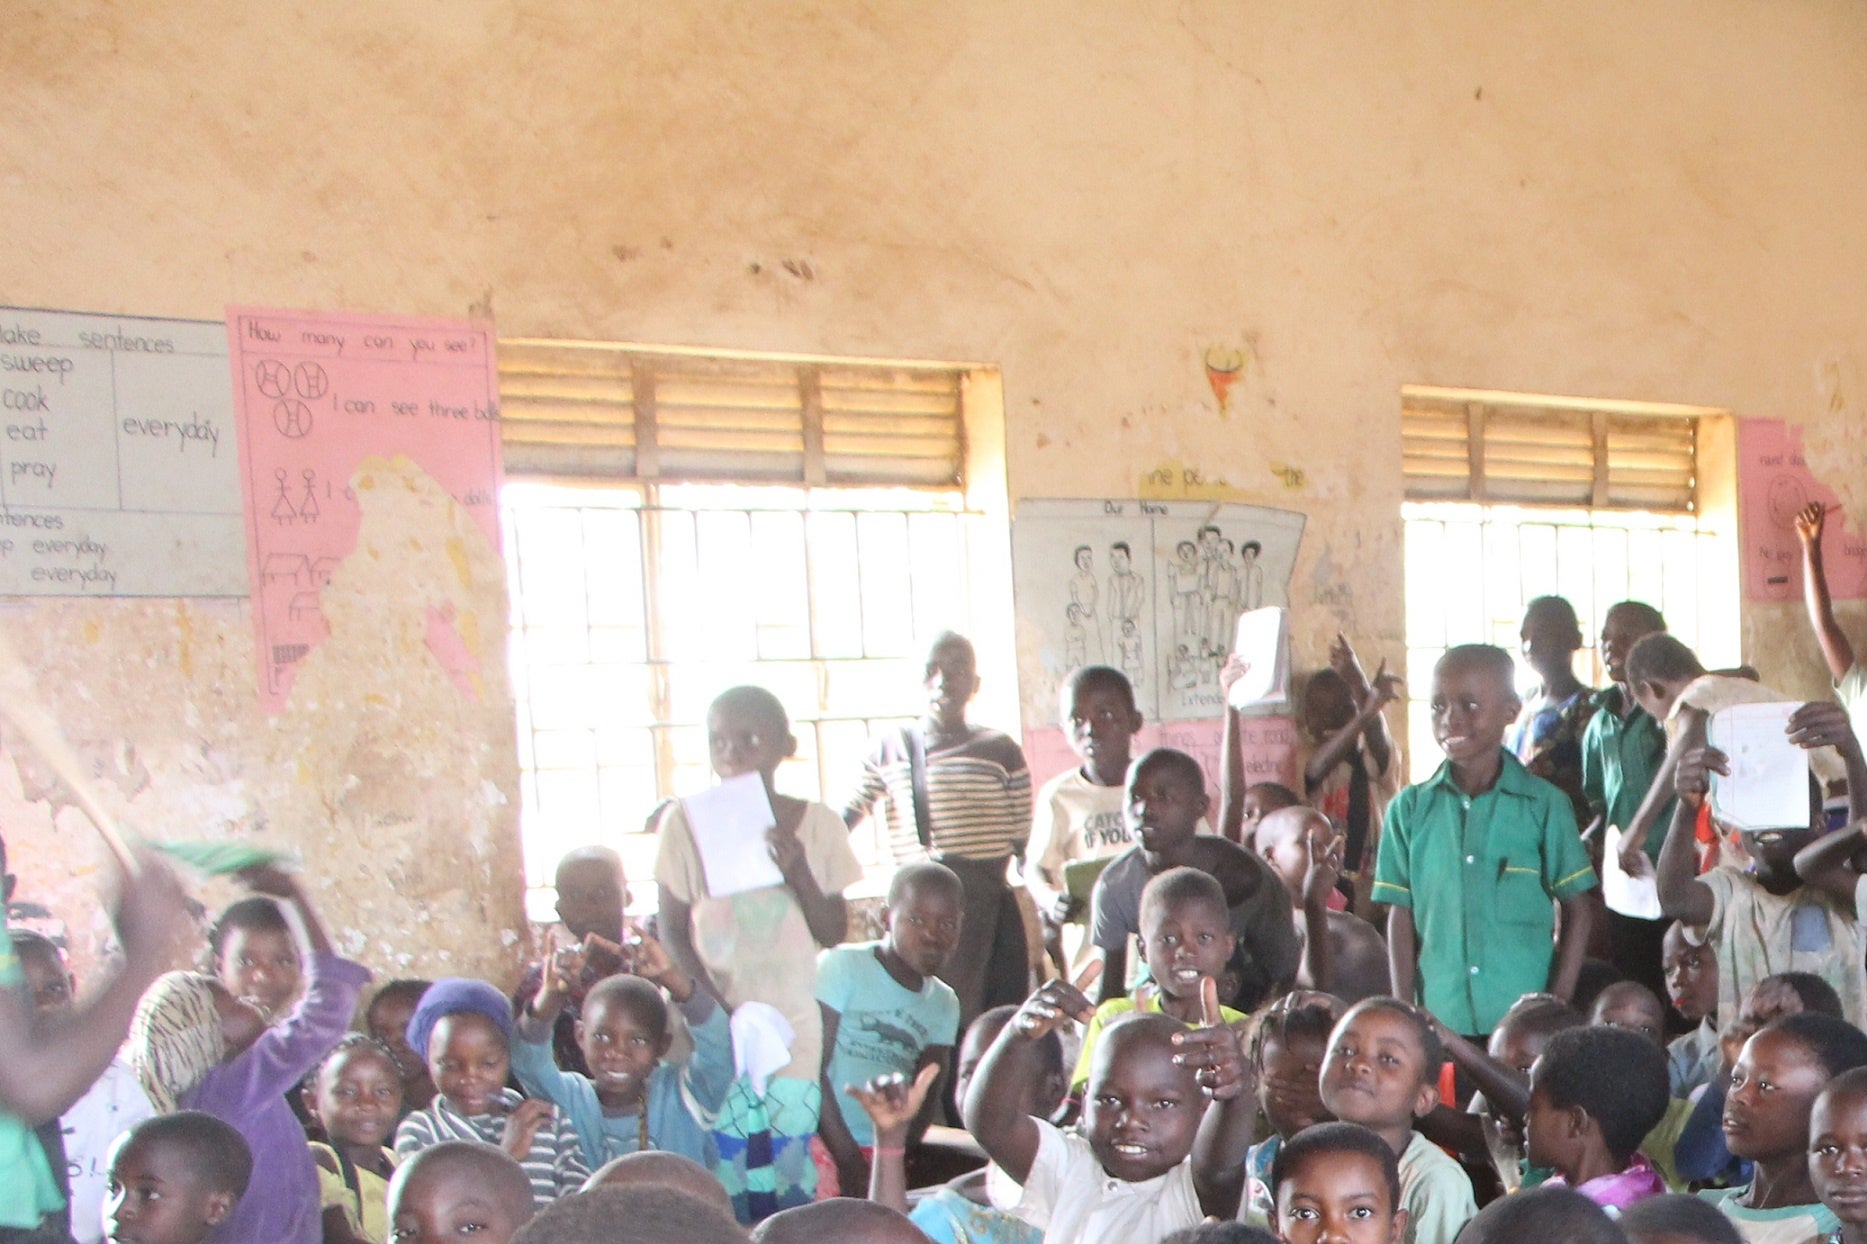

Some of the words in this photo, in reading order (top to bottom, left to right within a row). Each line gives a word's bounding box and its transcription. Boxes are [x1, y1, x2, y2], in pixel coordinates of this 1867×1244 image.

[78, 324, 176, 354] sentences
[248, 320, 282, 343] How
[302, 331, 344, 357] many
[364, 335, 394, 349] can
[409, 337, 436, 361] you
[1, 354, 74, 386] sweep
[3, 385, 50, 412] cook
[344, 401, 376, 414] can
[391, 401, 419, 416] see
[428, 400, 468, 421] three
[6, 416, 49, 442] eat
[122, 410, 220, 458] everyday
[11, 460, 57, 490] pray
[32, 534, 107, 563] everyday
[30, 563, 116, 591] everyday
